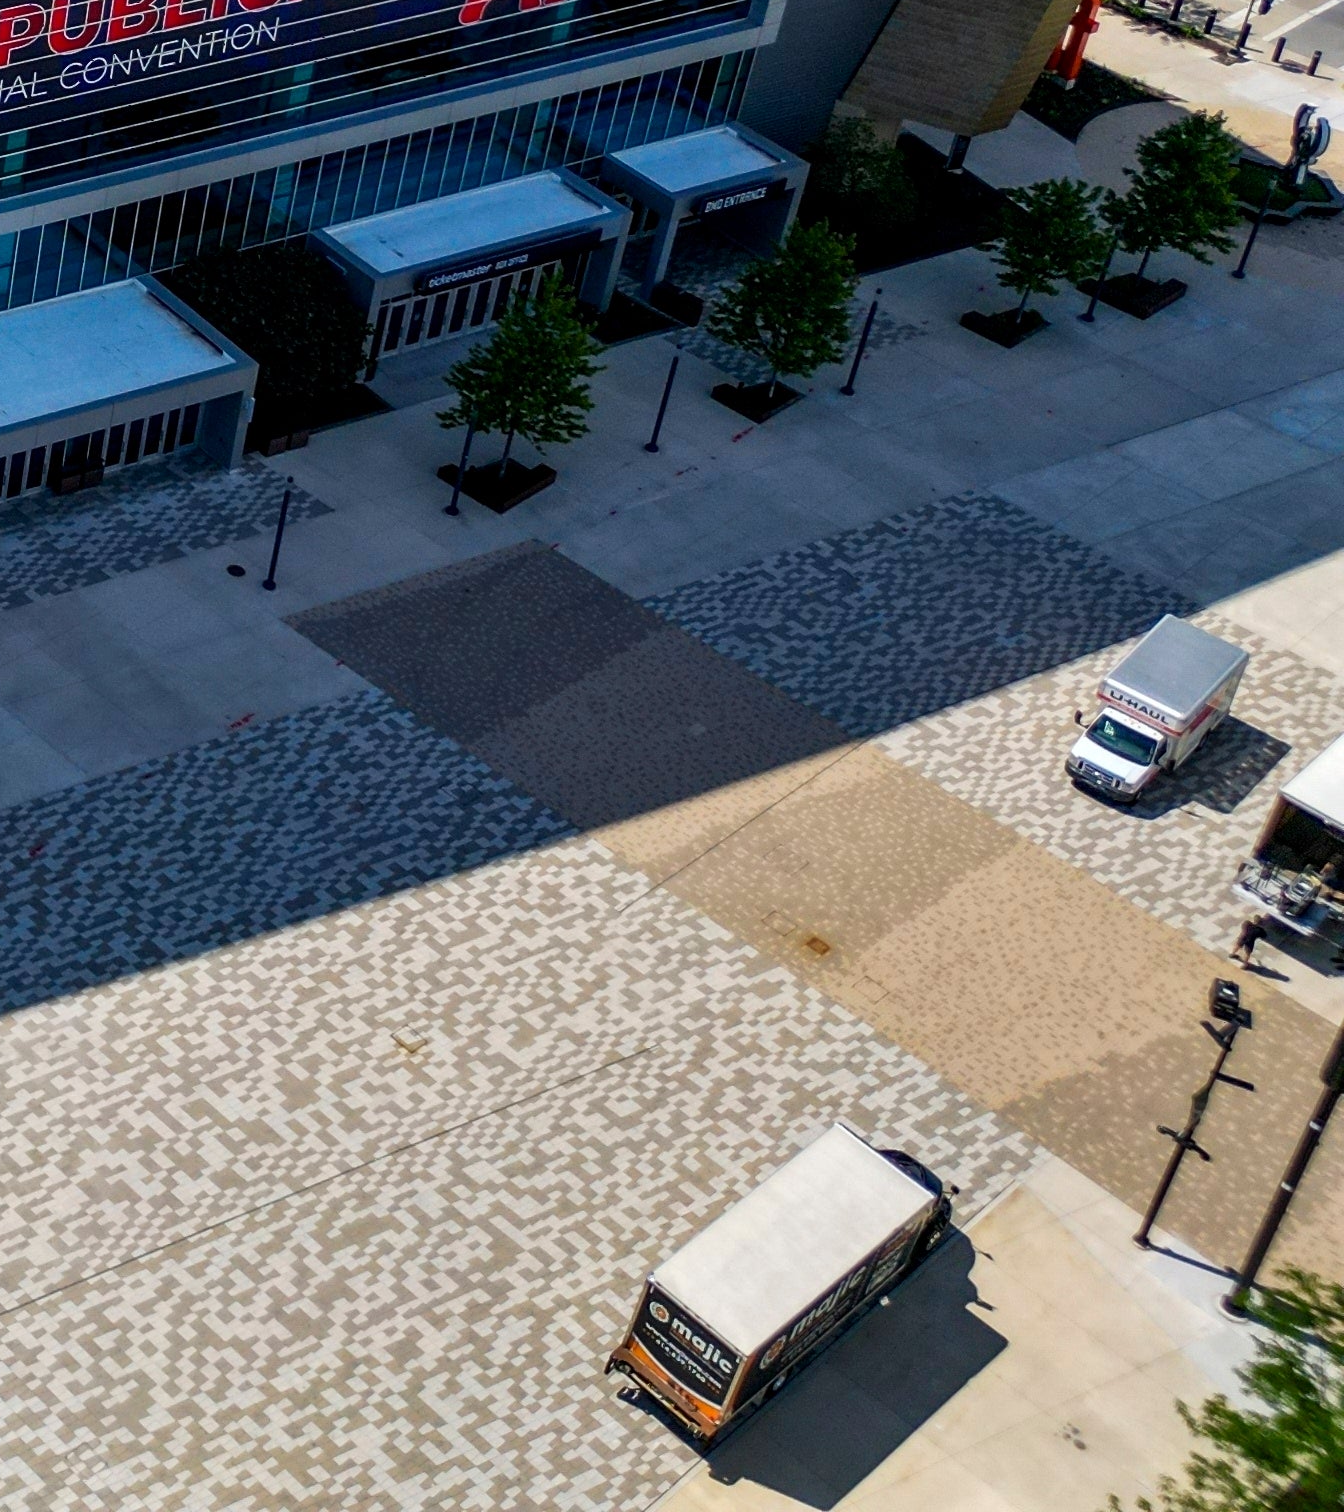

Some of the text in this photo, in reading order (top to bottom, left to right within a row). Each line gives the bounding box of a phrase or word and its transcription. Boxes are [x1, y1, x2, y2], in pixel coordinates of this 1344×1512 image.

[57, 16, 280, 98] CONVENTION
[723, 187, 767, 207] ENTRANCE
[428, 264, 493, 288] ticketmaster
[1109, 689, 1169, 725] U-HAUL
[670, 1317, 733, 1374] majic
